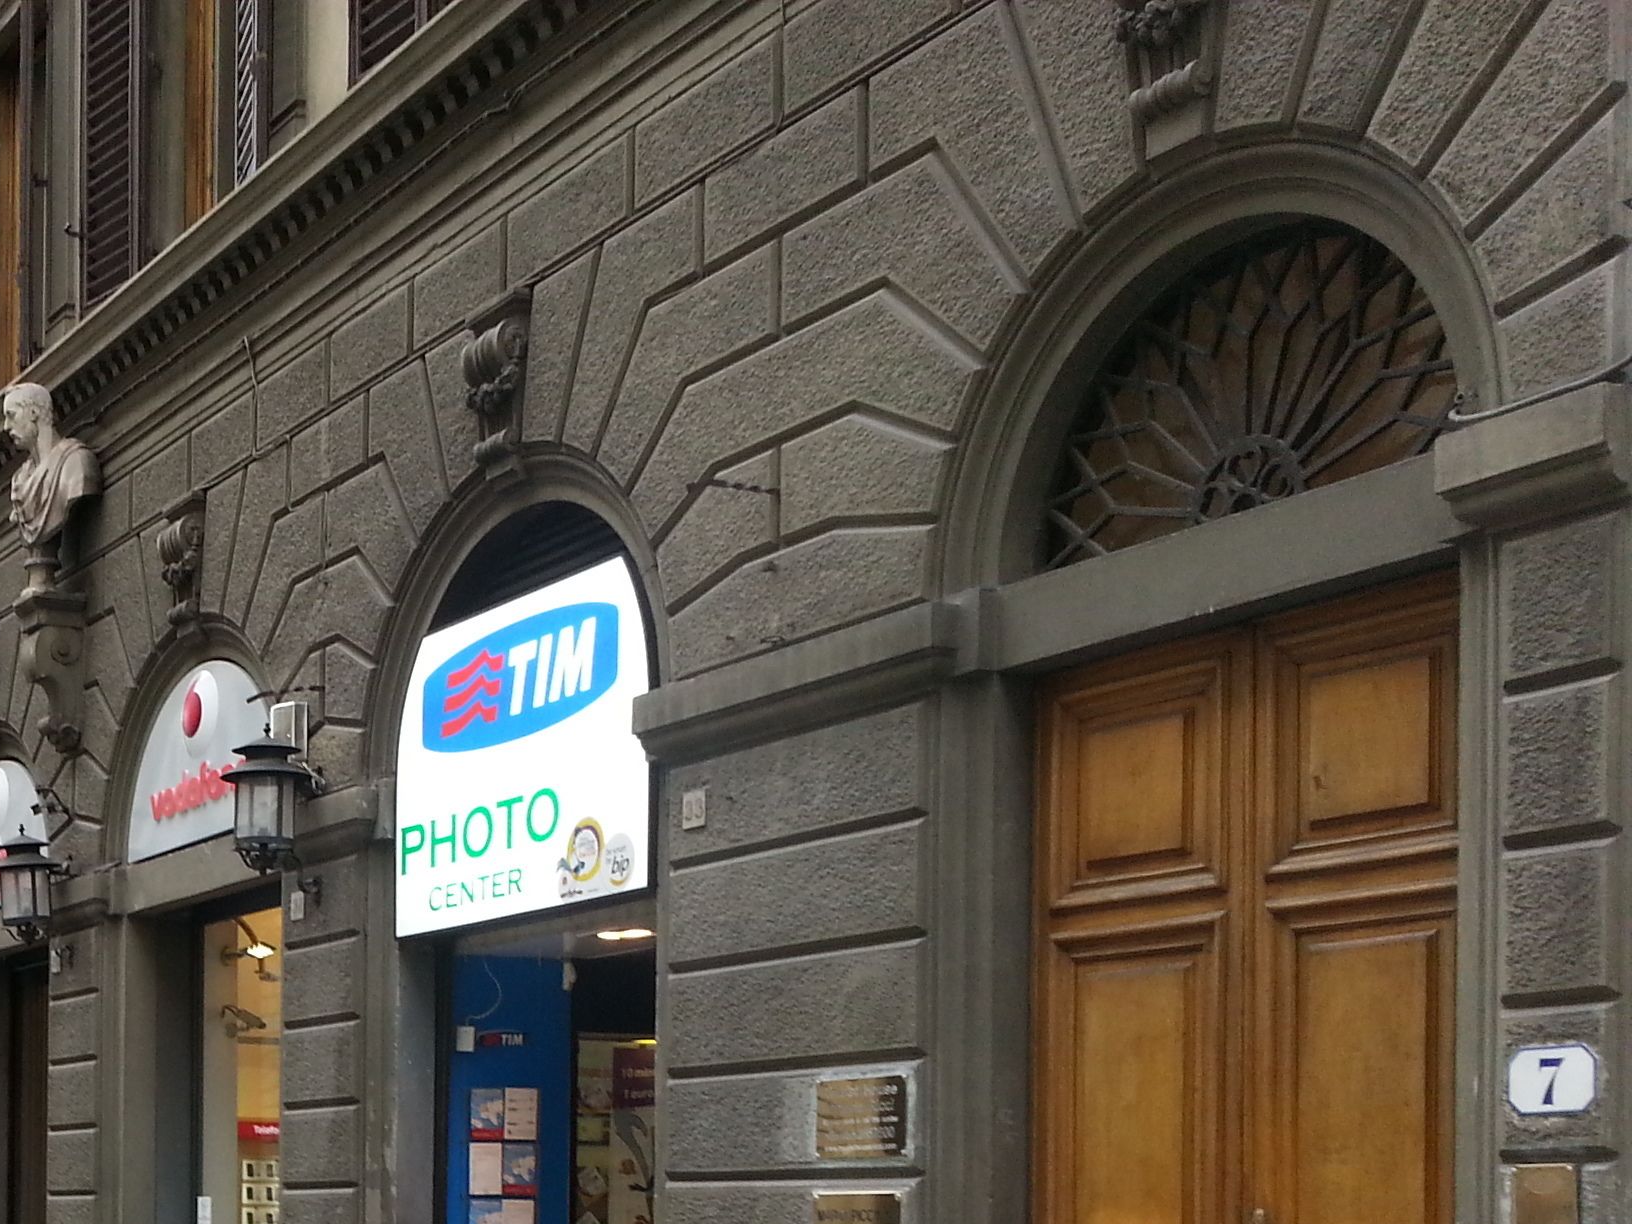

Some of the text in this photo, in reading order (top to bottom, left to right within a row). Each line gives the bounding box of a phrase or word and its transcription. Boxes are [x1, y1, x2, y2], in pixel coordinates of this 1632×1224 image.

[508, 617, 596, 716] TIM
[401, 788, 560, 877] PHOTO
[428, 866, 524, 911] CENTER
[501, 1033, 524, 1047] TIM
[1539, 1057, 1564, 1105] 7
